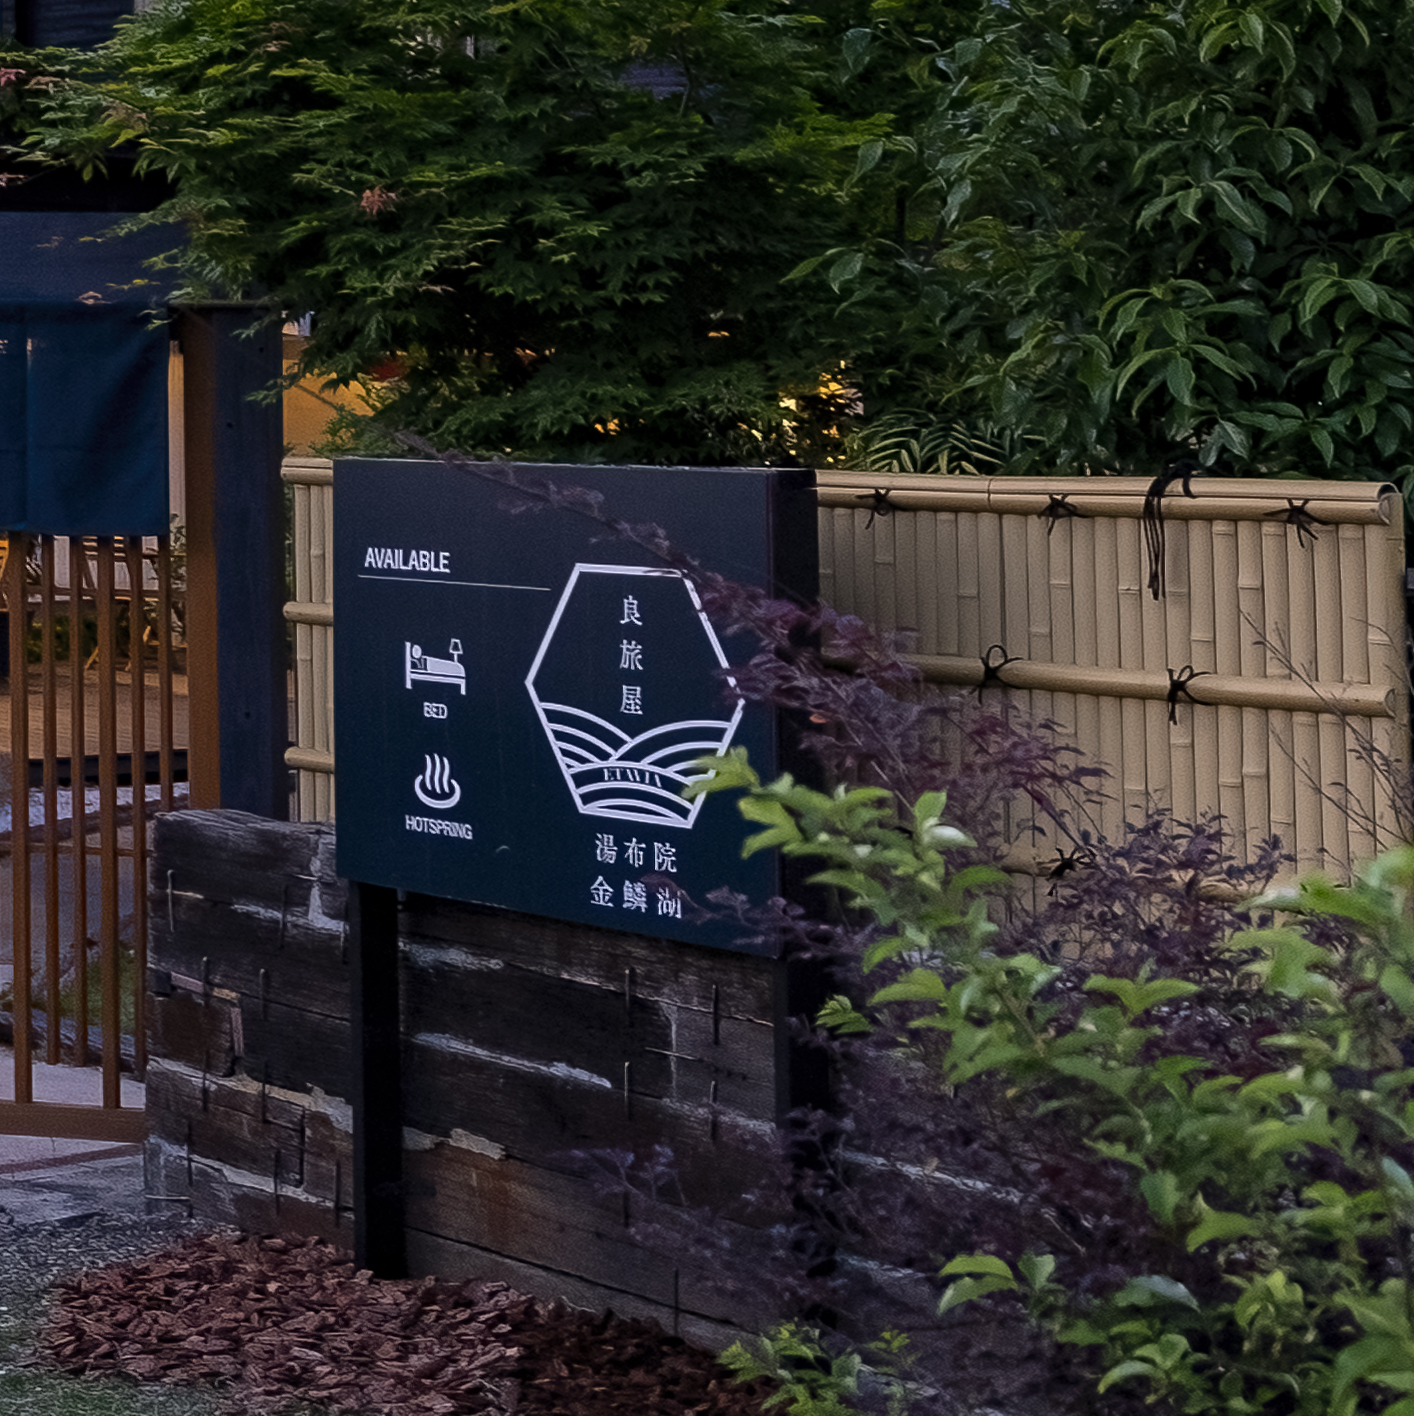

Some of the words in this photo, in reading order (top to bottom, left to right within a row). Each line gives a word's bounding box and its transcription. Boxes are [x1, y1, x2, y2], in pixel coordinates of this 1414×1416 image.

[364, 547, 451, 573] AVAILABLE
[619, 595, 643, 715] 良旅屋
[423, 702, 448, 719] BED
[405, 815, 473, 840] HOTSPRING
[595, 833, 677, 873] 湯布院
[590, 875, 682, 919] 金鱗湖
